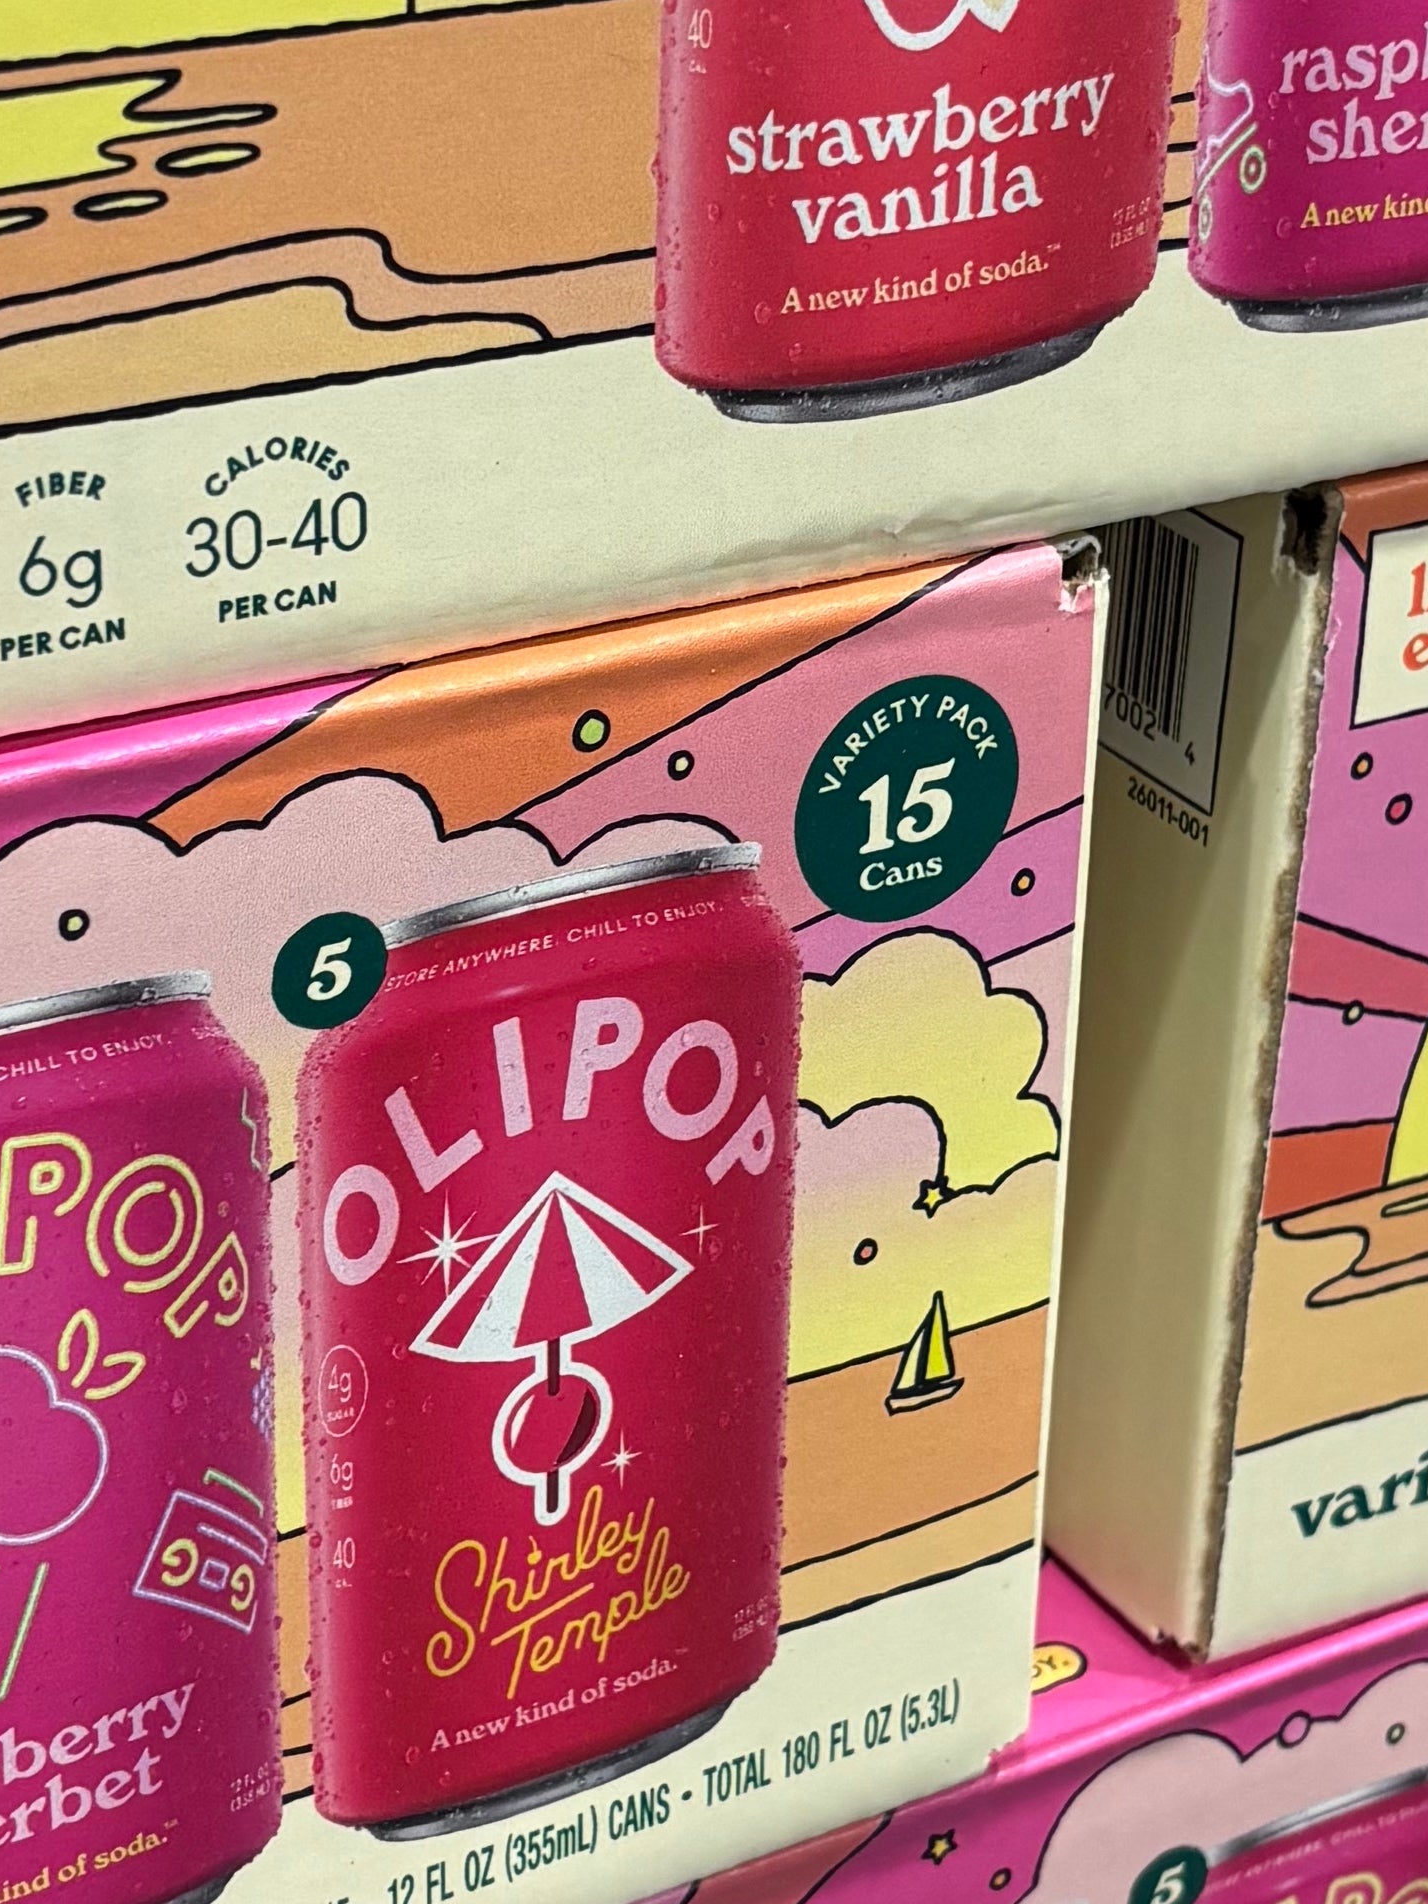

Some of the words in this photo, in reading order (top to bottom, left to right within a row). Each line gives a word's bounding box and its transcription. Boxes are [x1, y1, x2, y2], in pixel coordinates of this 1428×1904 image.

[688, 9, 712, 49] 40
[726, 72, 1113, 177] strawberry
[792, 154, 1042, 244] vanilla
[781, 287, 804, 315] A
[808, 286, 868, 312] new
[874, 270, 939, 303] kind
[944, 265, 974, 292] of
[15, 471, 106, 508] FIBER
[204, 436, 351, 497] CALORIES
[19, 536, 104, 608] 6g
[184, 491, 368, 578] 30-40
[218, 592, 269, 623] PER
[273, 580, 338, 613] CAN
[819, 693, 930, 796] VARIETY
[936, 695, 999, 760] PACK
[858, 757, 955, 855] 15
[1127, 776, 1209, 846] 26011-001
[859, 854, 943, 892] Cans
[306, 937, 352, 1001] 5
[323, 996, 775, 1286] OLIPOP
[425, 1485, 655, 1678] Shirley
[491, 1526, 691, 1700] Temple
[424, 1858, 455, 1903] FL
[464, 1846, 495, 1890] OZ
[505, 1802, 600, 1882] (355mL)
[608, 1784, 672, 1841] CANS
[703, 1745, 772, 1806] TOTAL
[782, 1732, 821, 1778] 180
[828, 1721, 854, 1763] FL
[863, 1707, 892, 1752] OZ
[899, 1678, 962, 1742] (5.3L)
